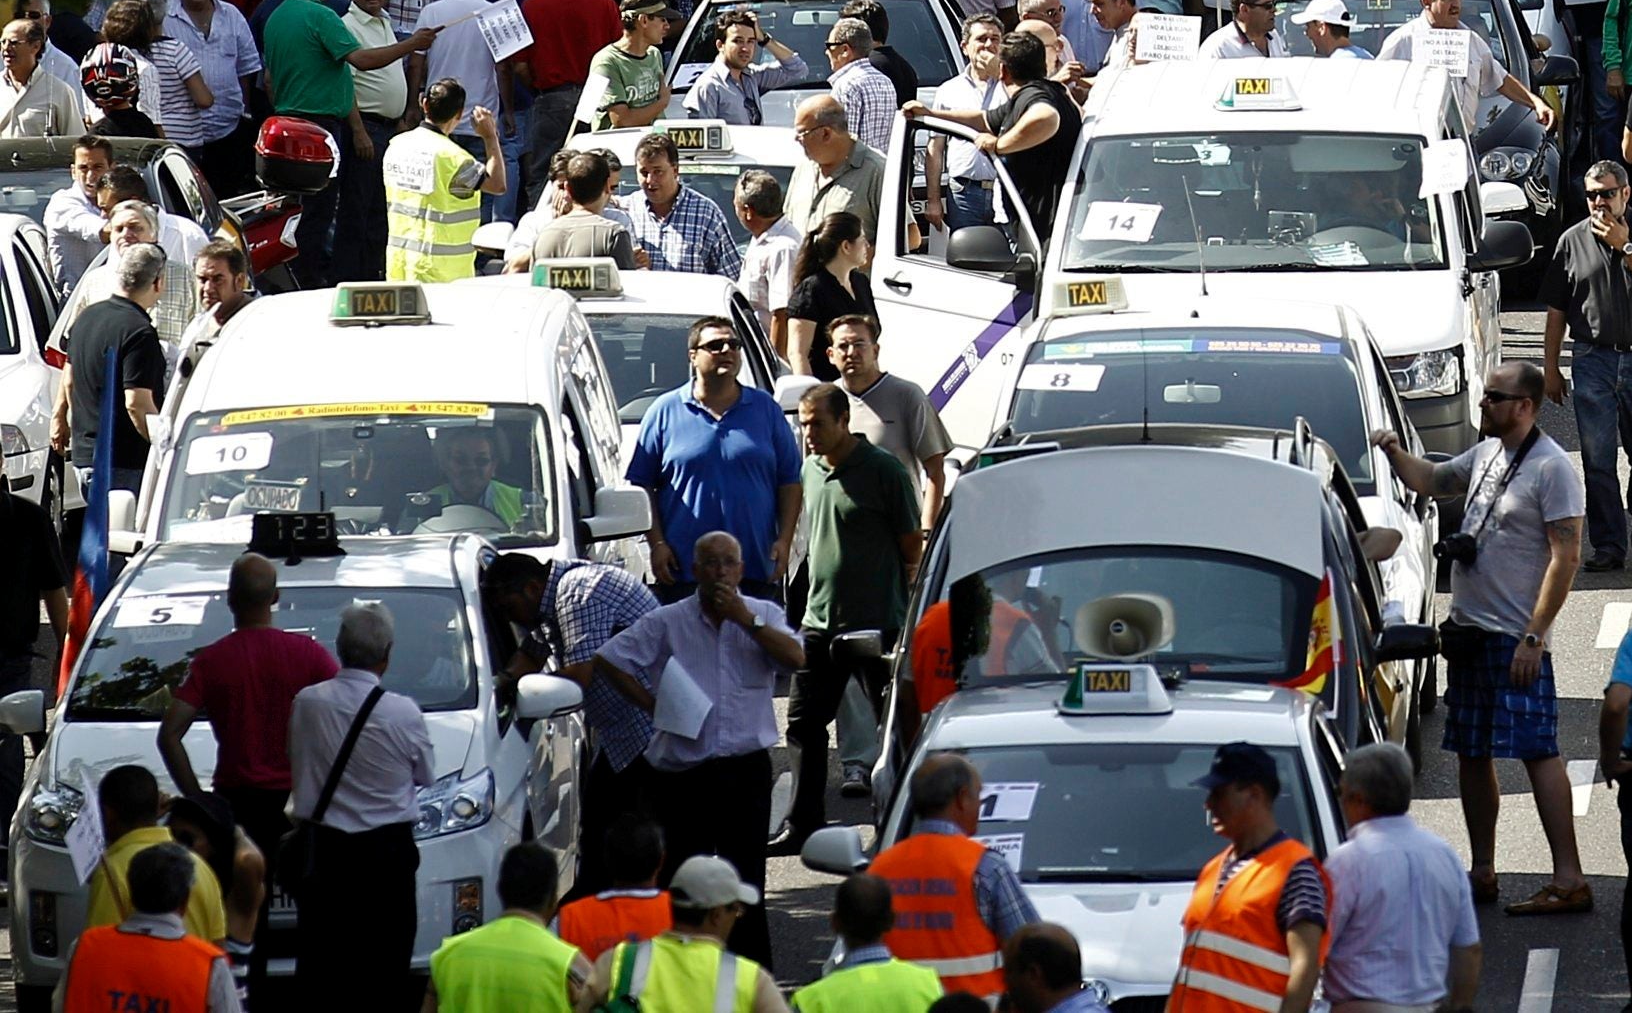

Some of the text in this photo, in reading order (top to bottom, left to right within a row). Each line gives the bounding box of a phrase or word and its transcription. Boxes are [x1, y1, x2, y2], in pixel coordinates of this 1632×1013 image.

[1235, 79, 1270, 95] TAXI
[669, 129, 704, 148] TAXI
[1108, 213, 1136, 232] 14
[549, 267, 591, 290] TAXI
[353, 289, 396, 314] TAXI
[1068, 282, 1108, 303] TAXI
[1050, 373, 1070, 387] 8
[215, 445, 247, 464] 10
[273, 511, 336, 541] 123
[152, 605, 173, 624] 5
[1085, 670, 1130, 693] TAXI
